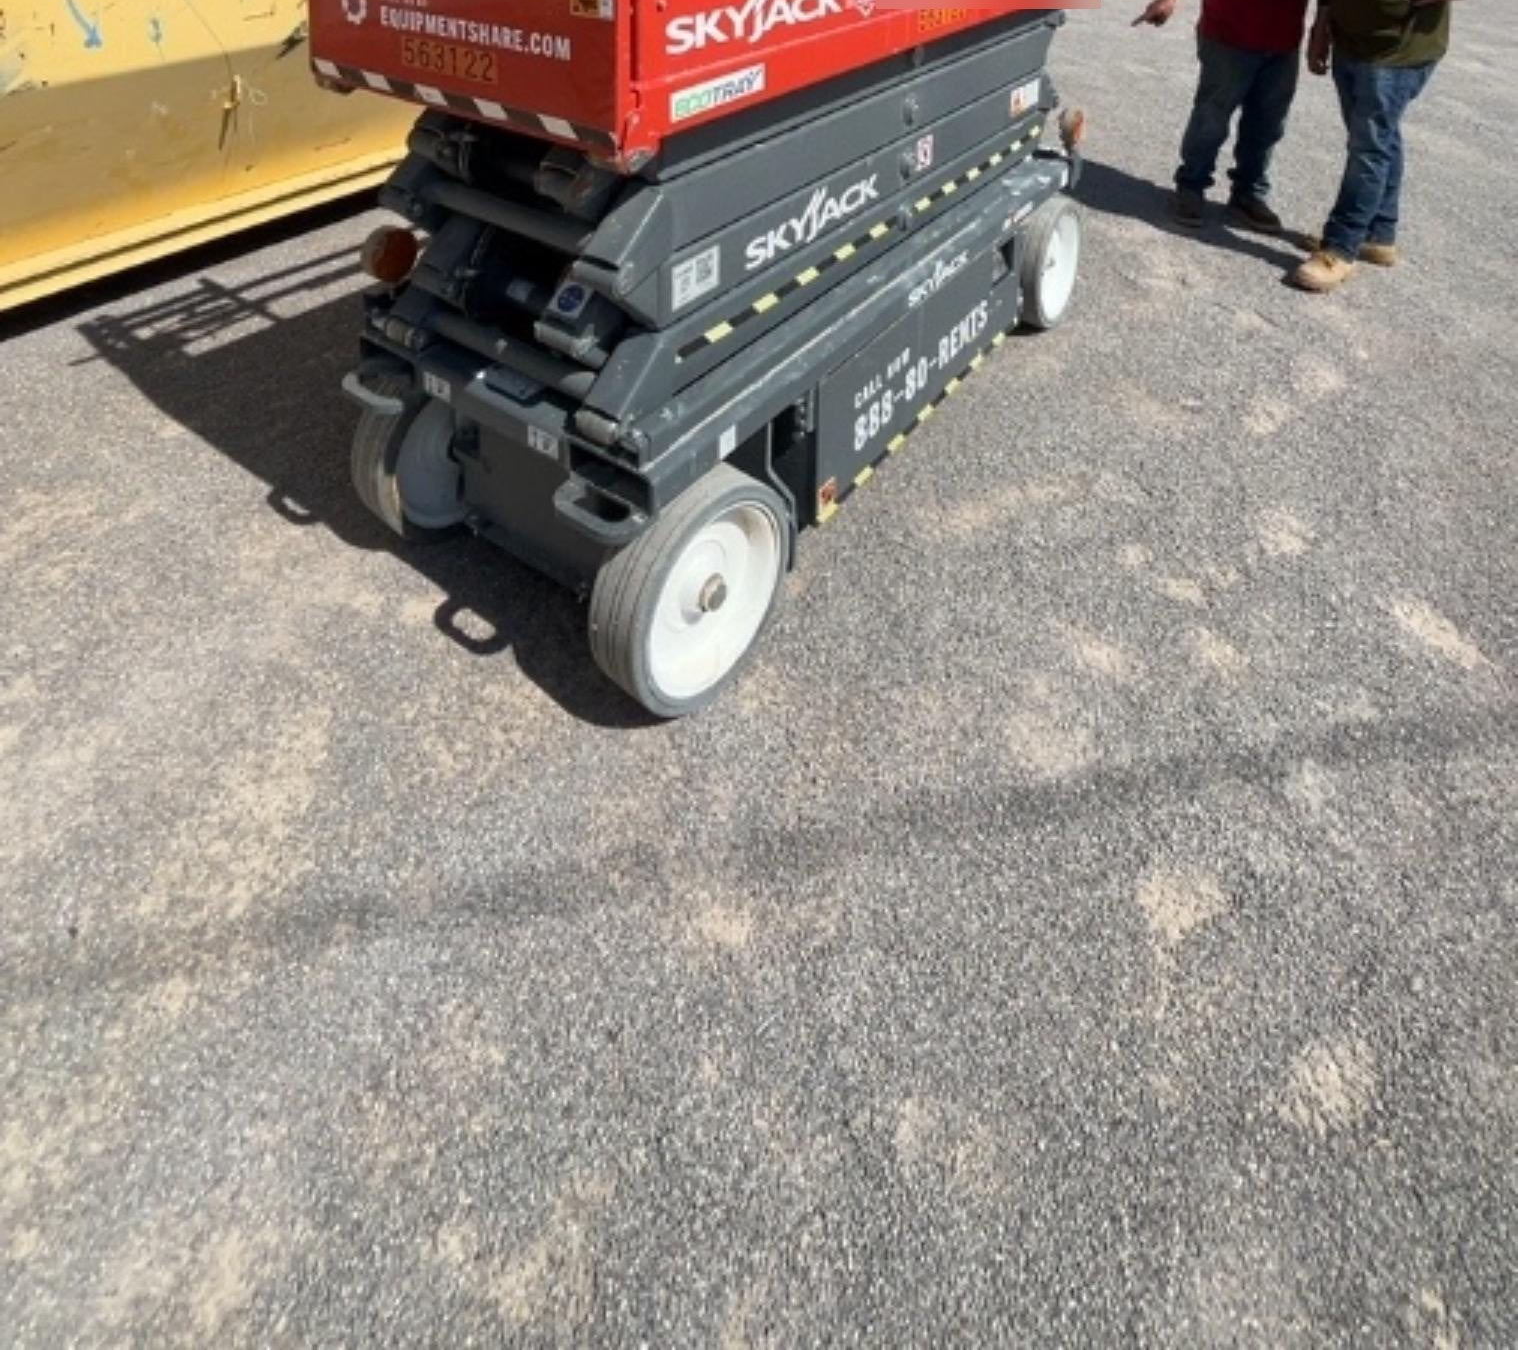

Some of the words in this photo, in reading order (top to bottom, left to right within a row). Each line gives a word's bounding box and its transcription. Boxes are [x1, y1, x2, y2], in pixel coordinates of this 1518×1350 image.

[379, 4, 571, 62] EQUIPMENTSHARE.COM
[403, 37, 494, 83] 563122
[743, 172, 880, 272] SKYJACK
[908, 250, 969, 308] SKYJACK
[853, 299, 989, 452] 888-80-RENTS
[854, 373, 884, 410] CALL
